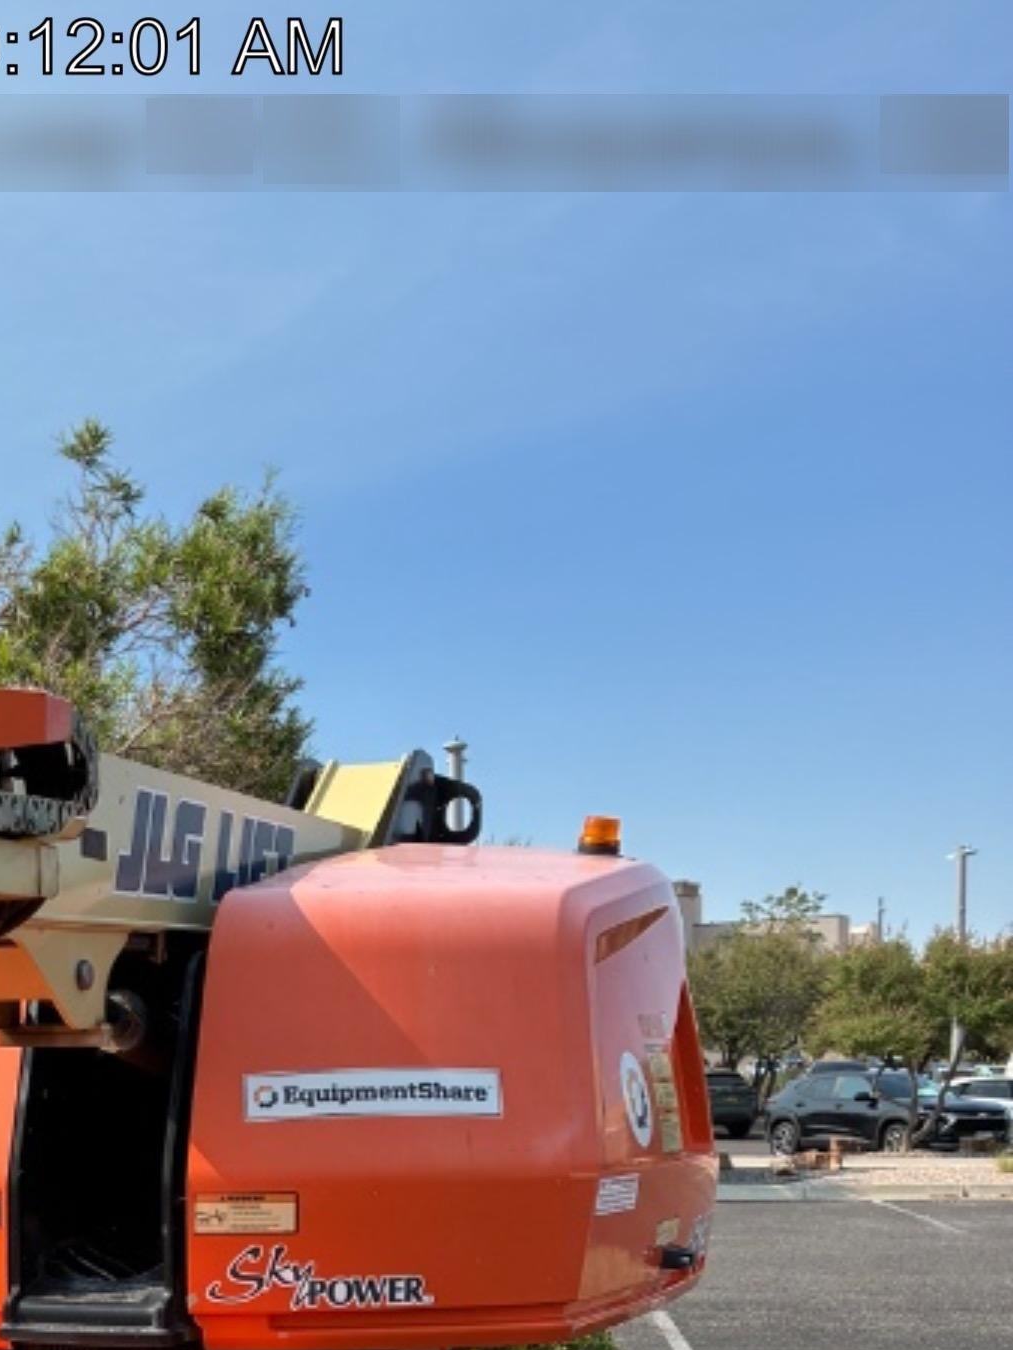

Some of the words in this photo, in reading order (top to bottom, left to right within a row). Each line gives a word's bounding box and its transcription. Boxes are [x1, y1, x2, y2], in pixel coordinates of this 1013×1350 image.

[114, 786, 208, 903] JLG
[283, 1081, 488, 1106] EquipmentShare
[304, 1274, 425, 1307] POWER
